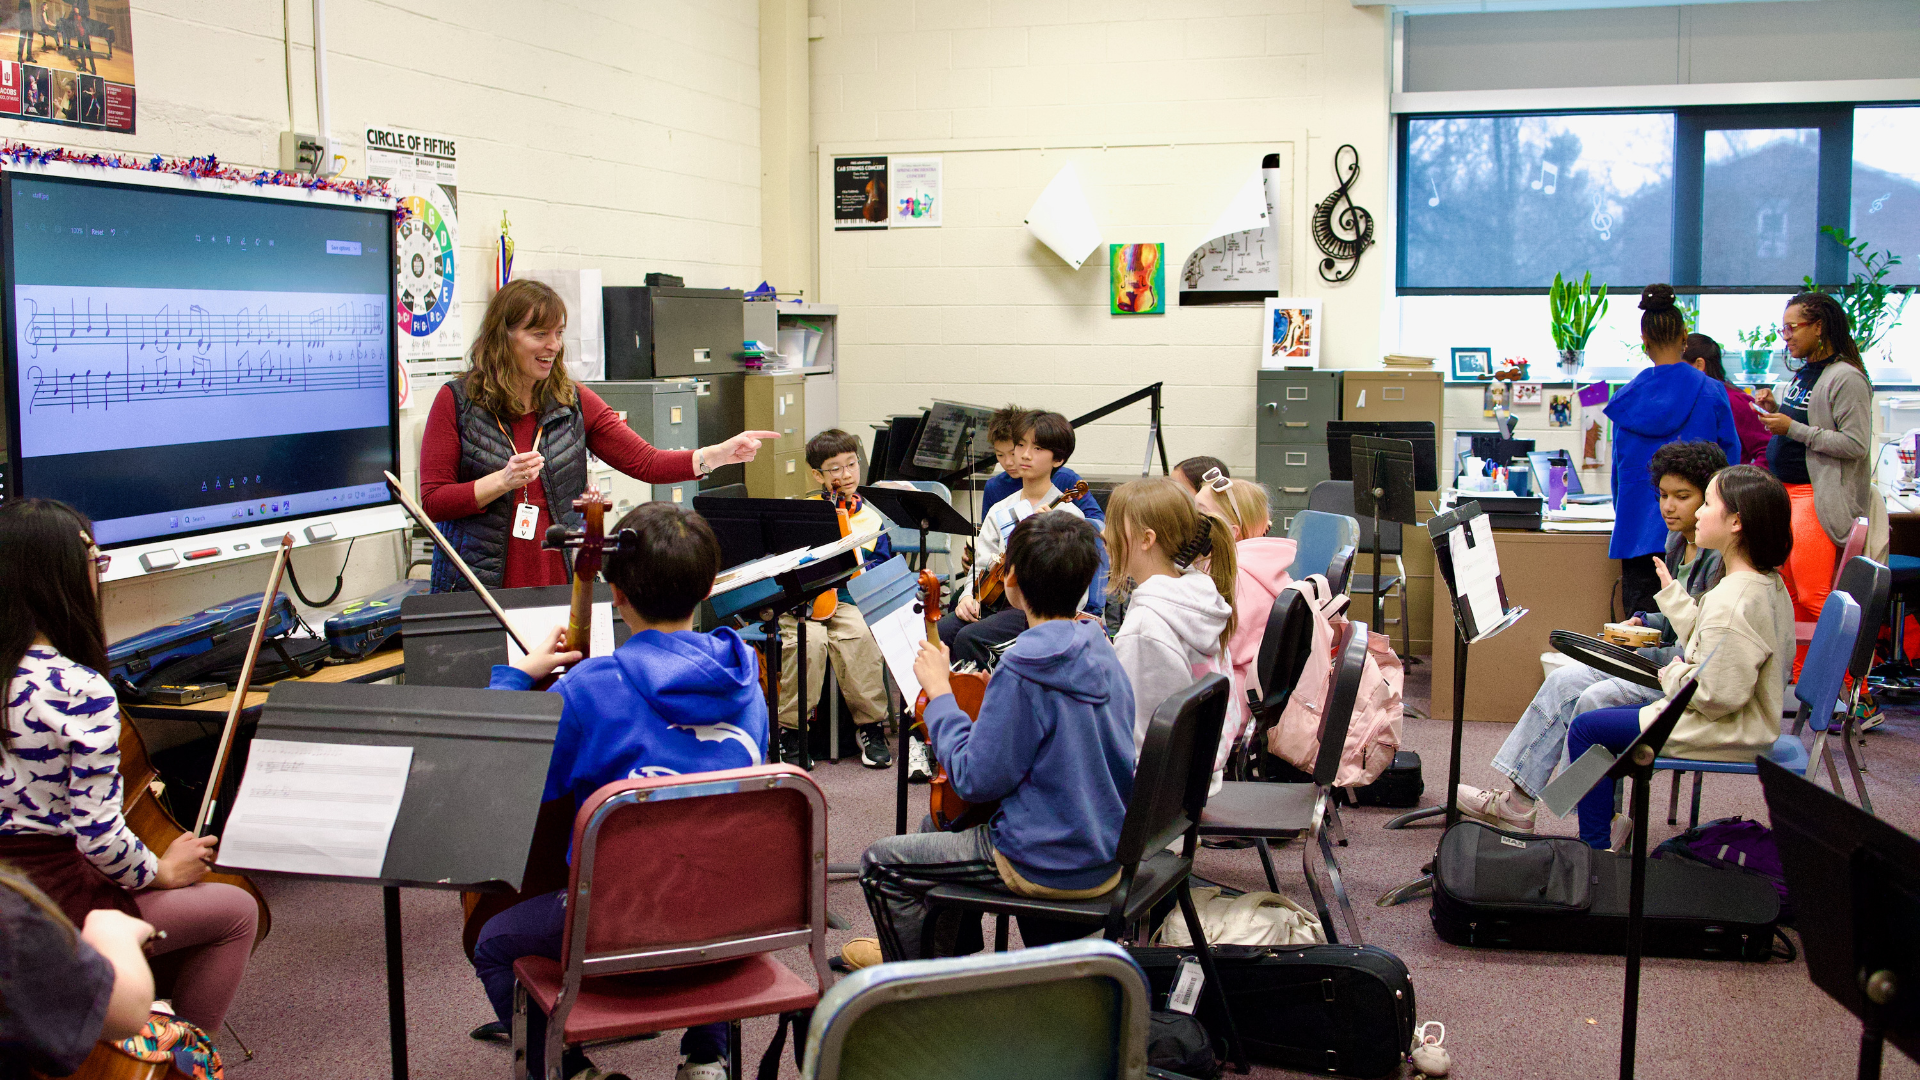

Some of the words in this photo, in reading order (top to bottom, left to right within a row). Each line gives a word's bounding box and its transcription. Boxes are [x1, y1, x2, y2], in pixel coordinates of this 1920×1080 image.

[0, 87, 17, 96] ACOBS
[366, 128, 405, 148] CIRCLE
[407, 135, 420, 150] OF
[423, 137, 455, 156] FIFTHS
[414, 198, 420, 214] C
[429, 208, 435, 225] G
[441, 230, 447, 246] D
[445, 258, 452, 274] A
[443, 286, 448, 302] E
[1502, 836, 1525, 847] MAX
